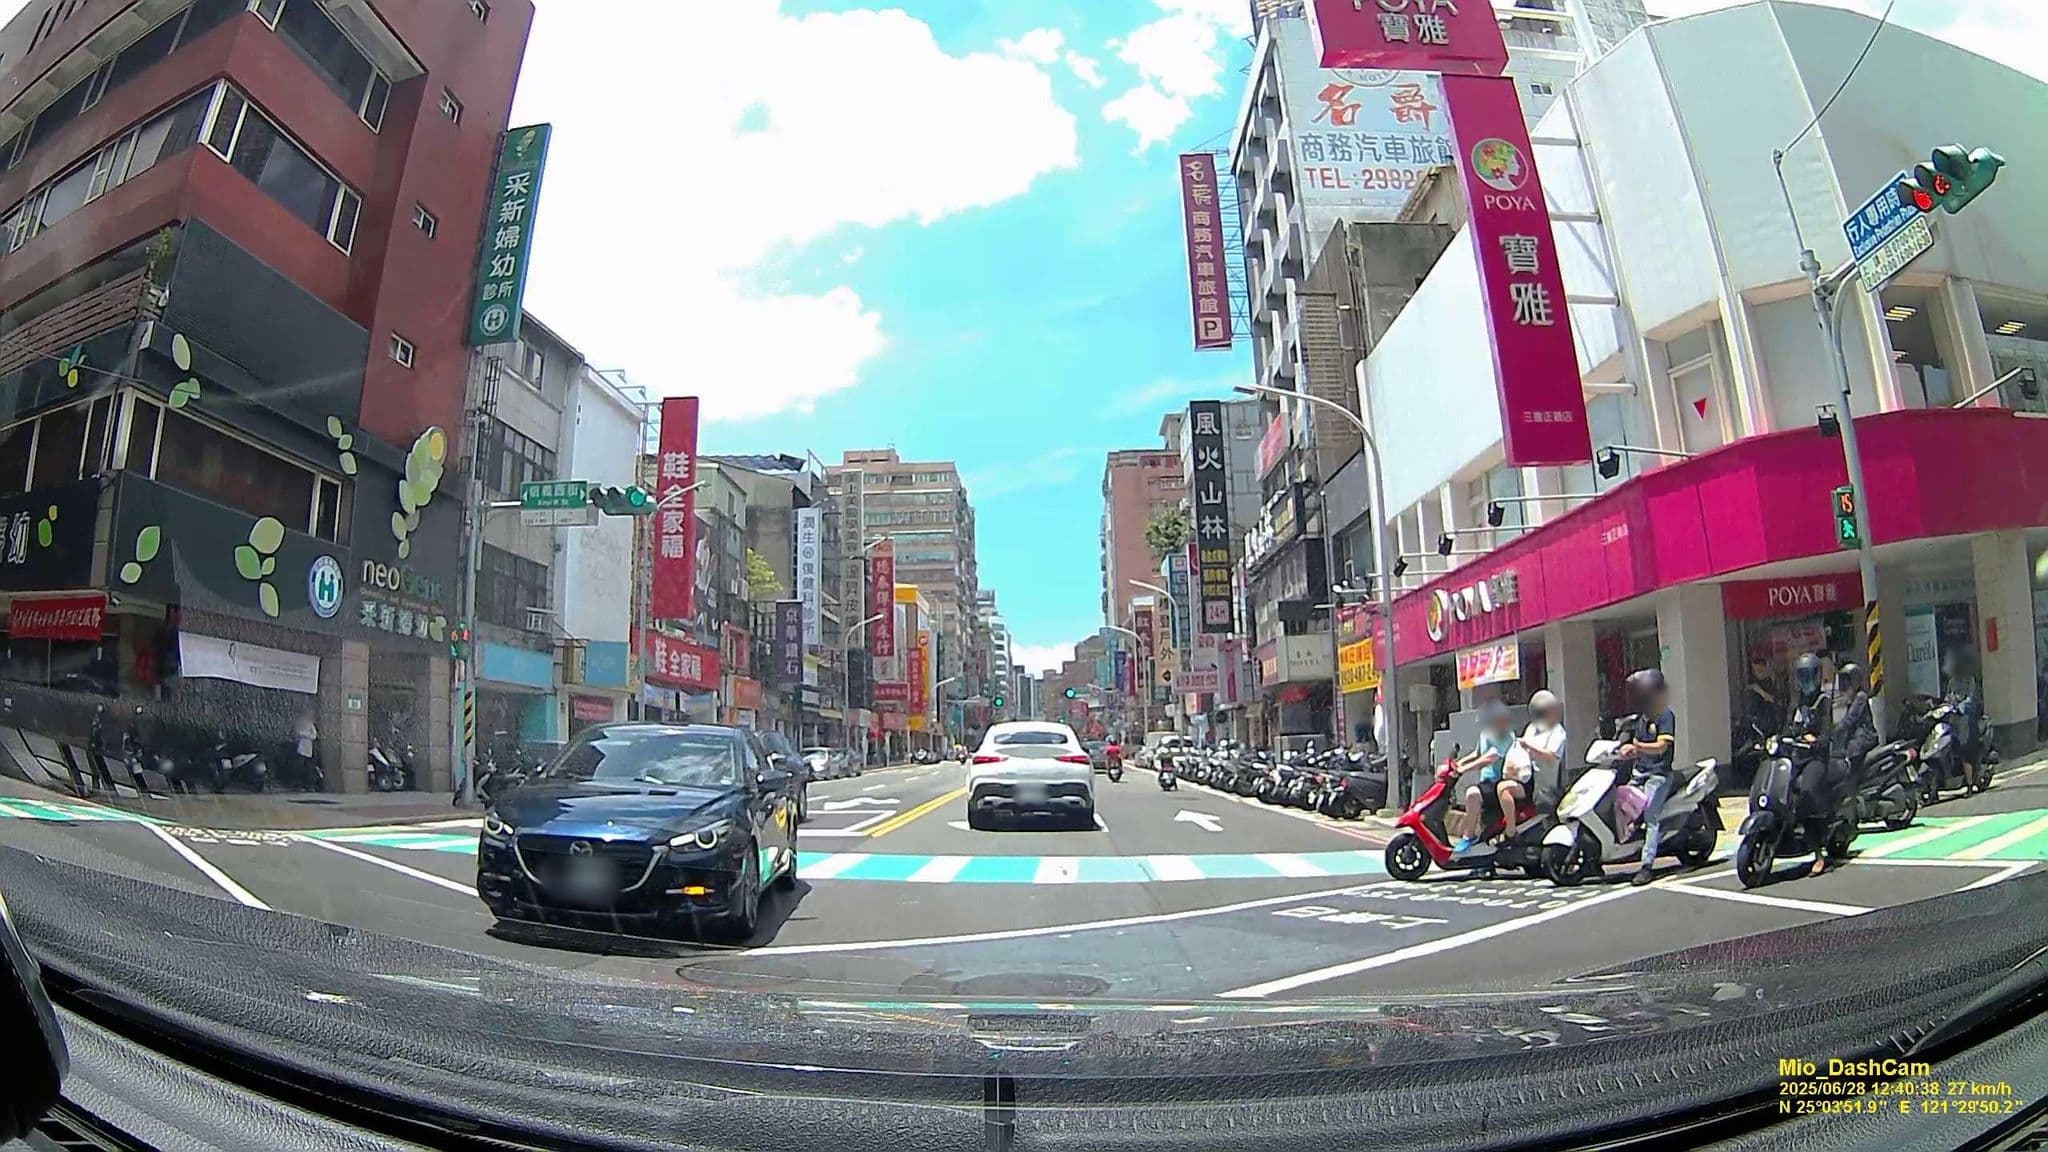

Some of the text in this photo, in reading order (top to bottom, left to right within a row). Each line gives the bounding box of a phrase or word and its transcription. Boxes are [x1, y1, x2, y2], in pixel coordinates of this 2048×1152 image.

[1377, 13, 1448, 43] 寶雅
[1301, 133, 1454, 164] 商務汽車旅館
[1484, 194, 1537, 211] POYA
[1846, 182, 1902, 244] 行人專用時
[489, 172, 531, 278] 采新婦幼
[482, 280, 513, 300] 診所
[1499, 233, 1554, 326] 寶雅
[1204, 319, 1217, 337] P
[1194, 412, 1226, 540] 風火山林
[661, 451, 690, 559] 鞋全家福
[1768, 585, 1812, 606] POYA
[655, 637, 702, 681] 鞋全家福
